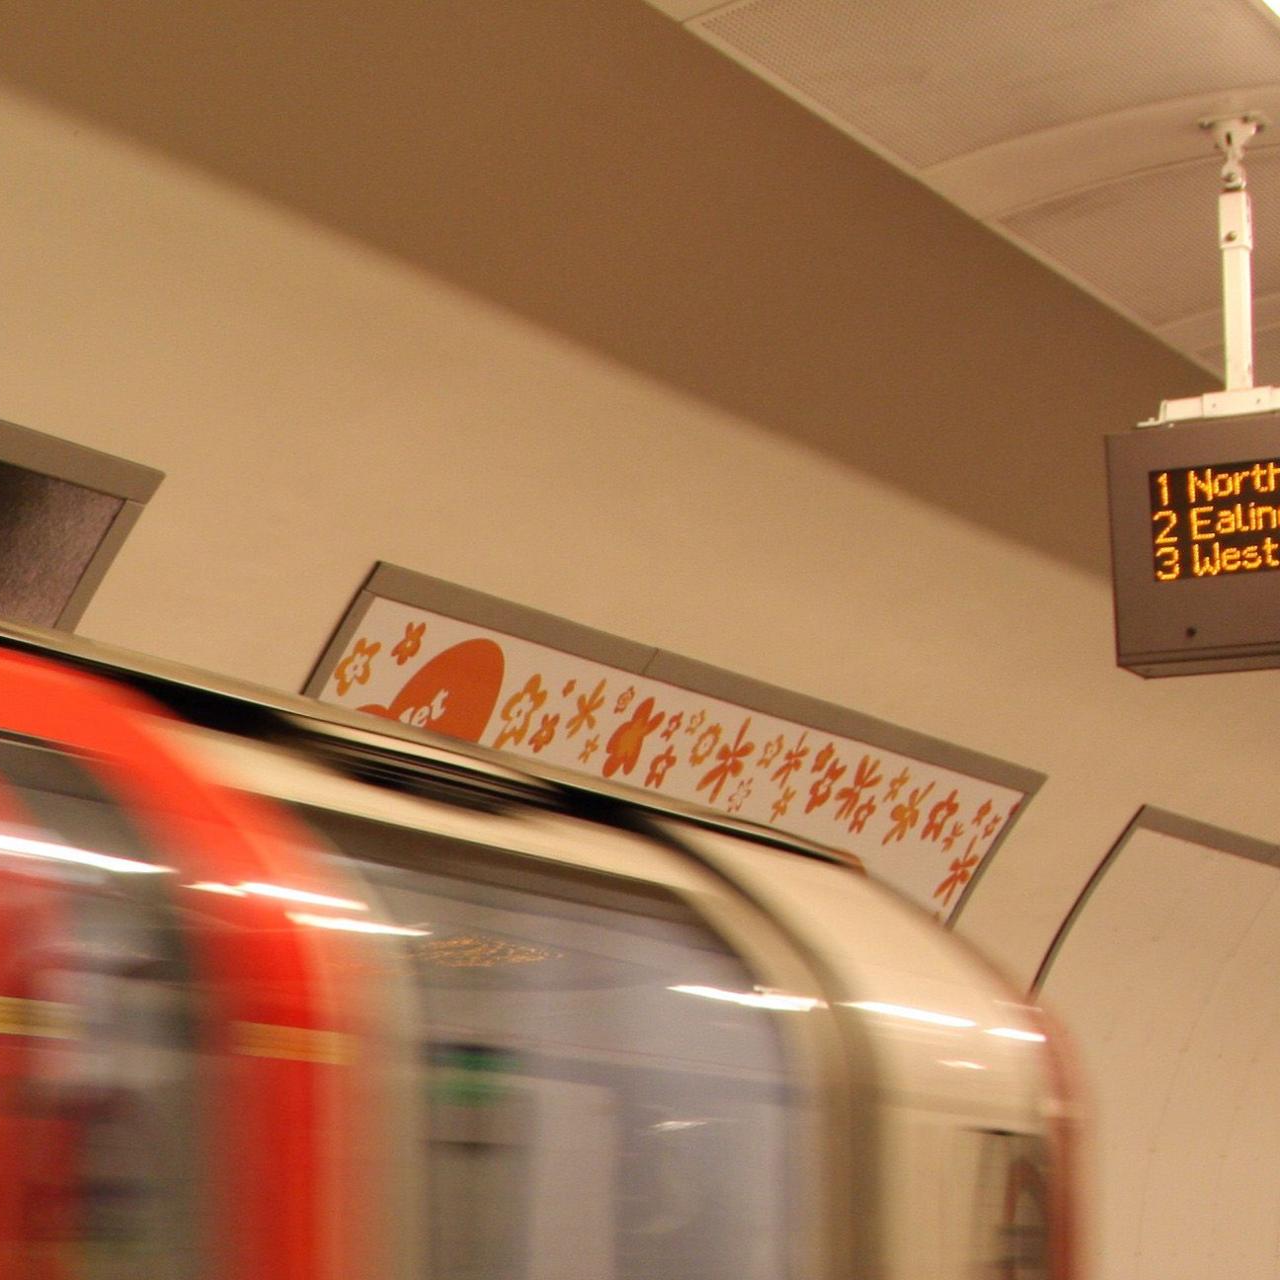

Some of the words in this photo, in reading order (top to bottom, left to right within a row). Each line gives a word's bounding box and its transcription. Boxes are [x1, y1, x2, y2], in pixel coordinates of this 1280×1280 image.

[1157, 472, 1169, 506] 1
[1153, 510, 1178, 544] 2
[1190, 502, 1280, 540] Ealin
[1156, 546, 1180, 580] 3
[1192, 537, 1280, 576] West
